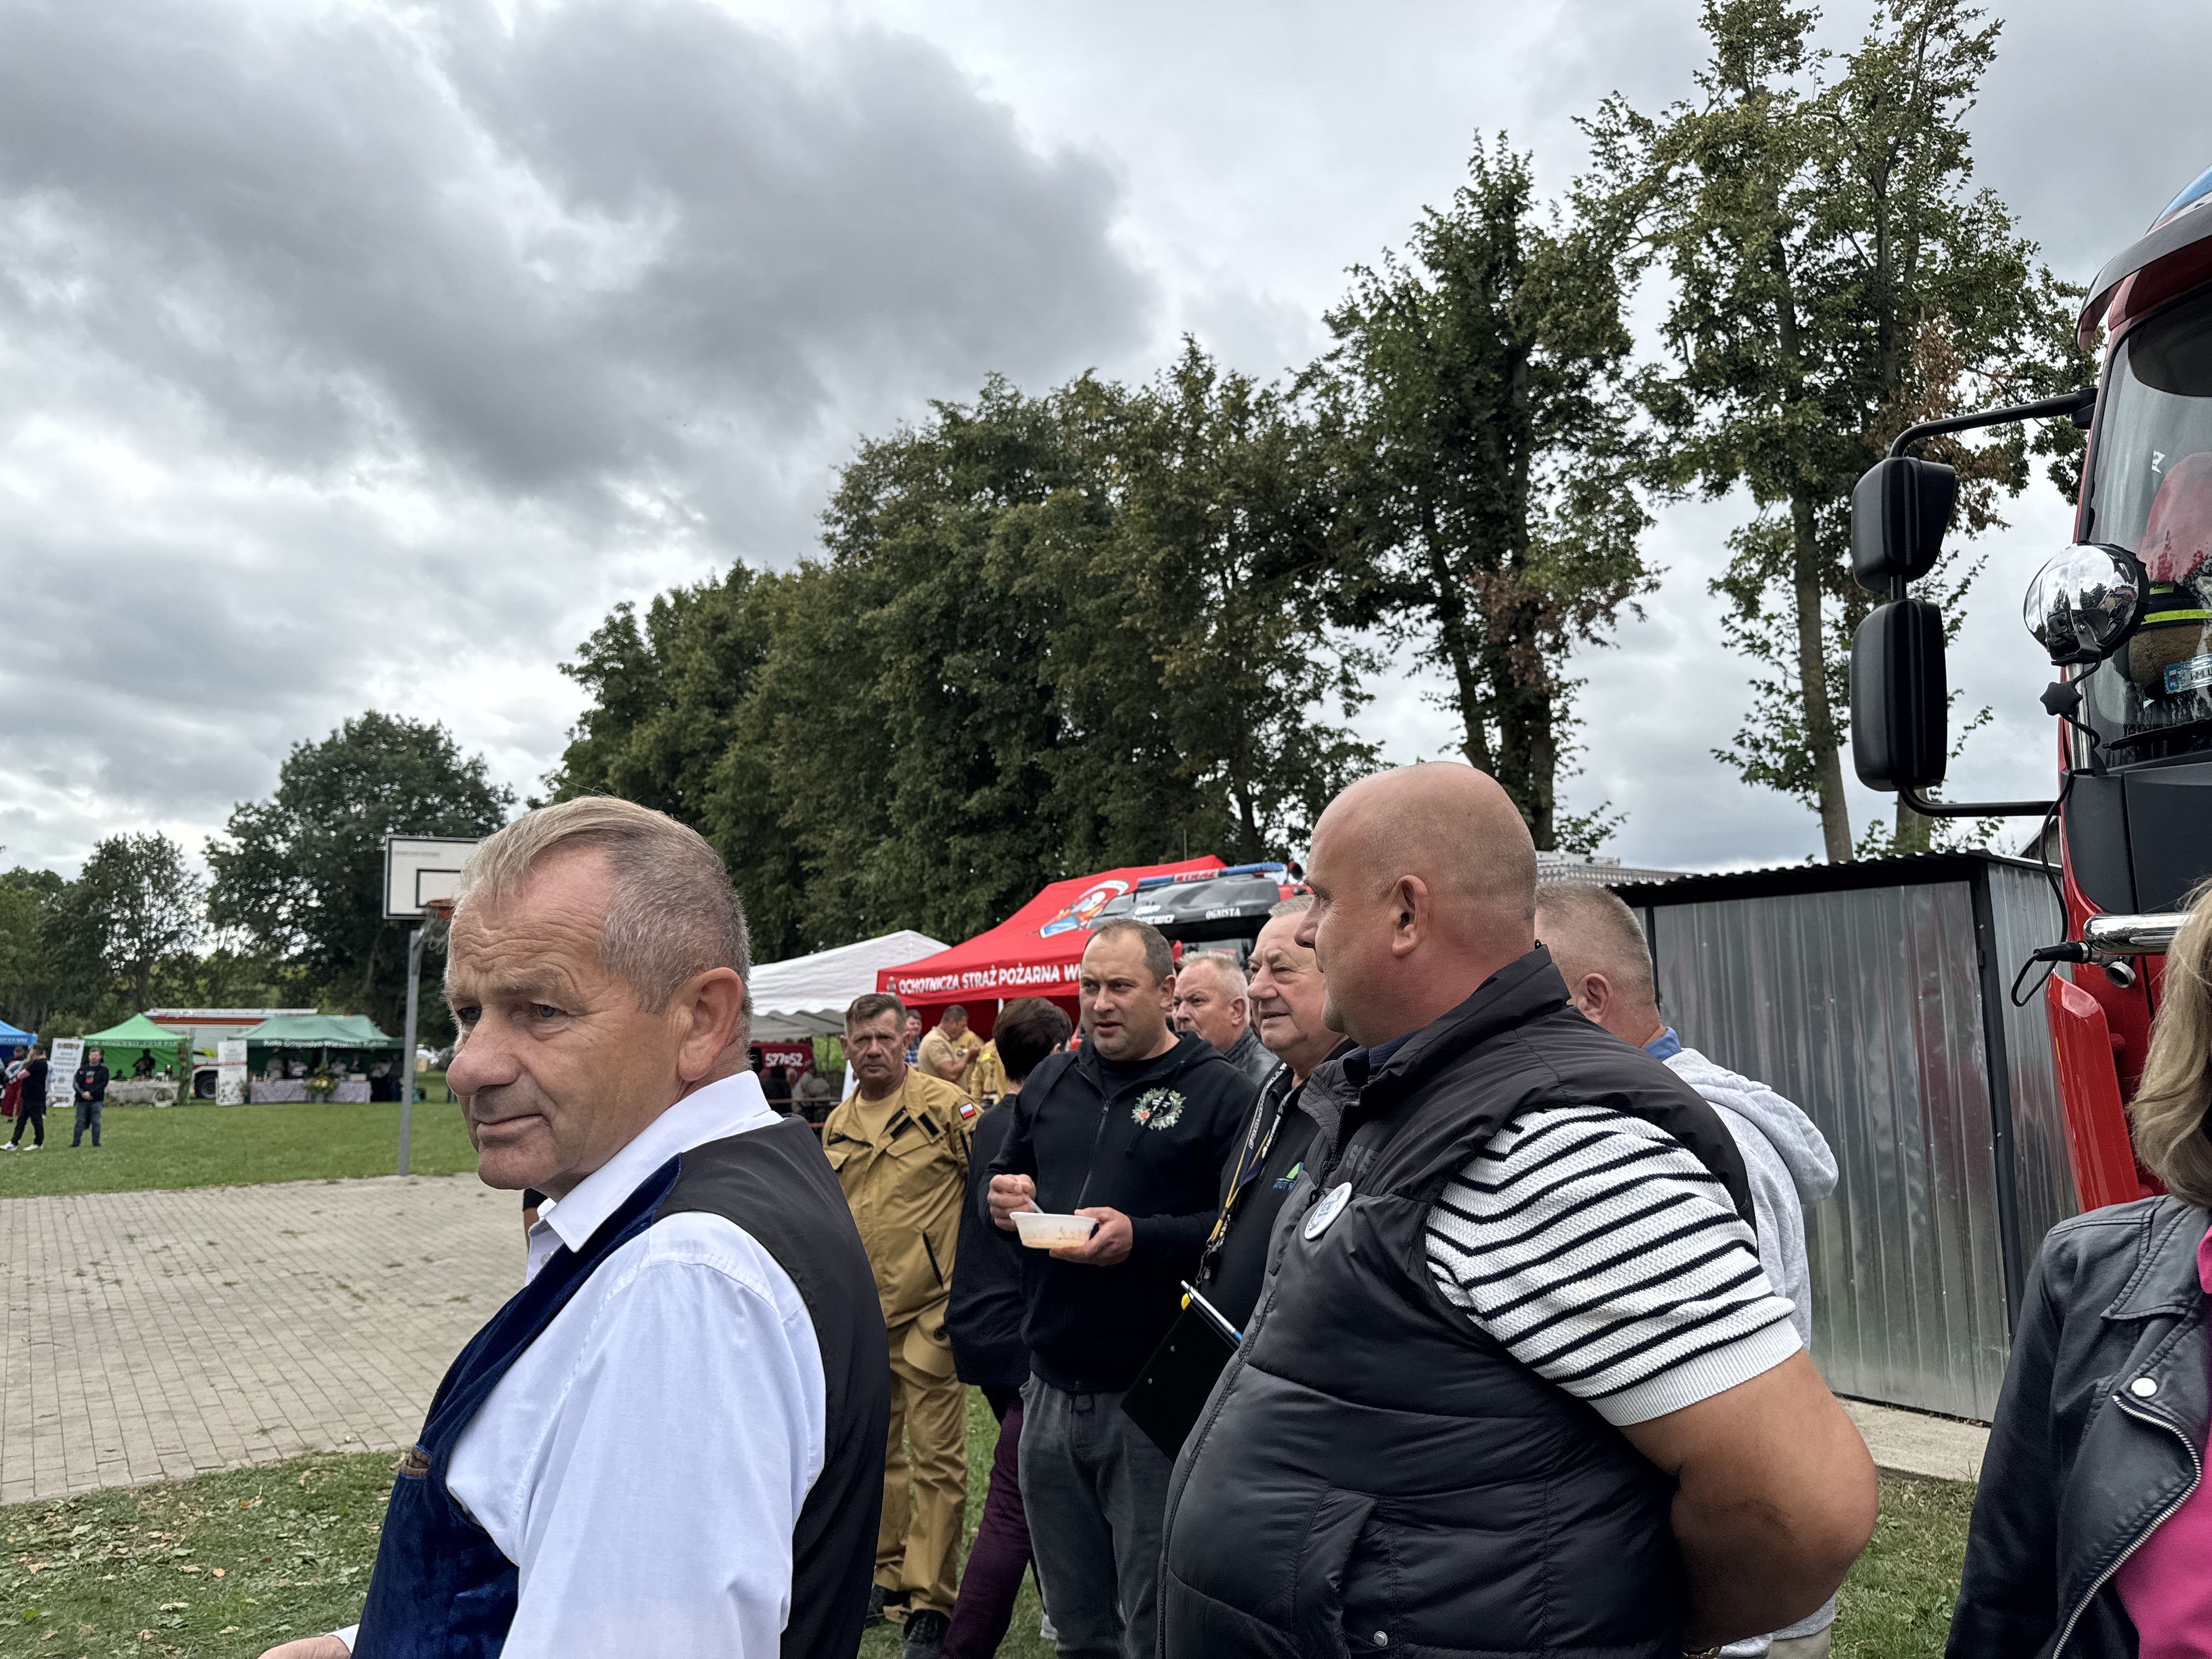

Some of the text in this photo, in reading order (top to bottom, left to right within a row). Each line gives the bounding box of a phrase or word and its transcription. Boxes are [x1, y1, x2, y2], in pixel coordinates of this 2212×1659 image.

[898, 974, 960, 995] OCHOTNICZA
[962, 964, 996, 989] STRAŻ
[998, 962, 1060, 986] POŻARNA
